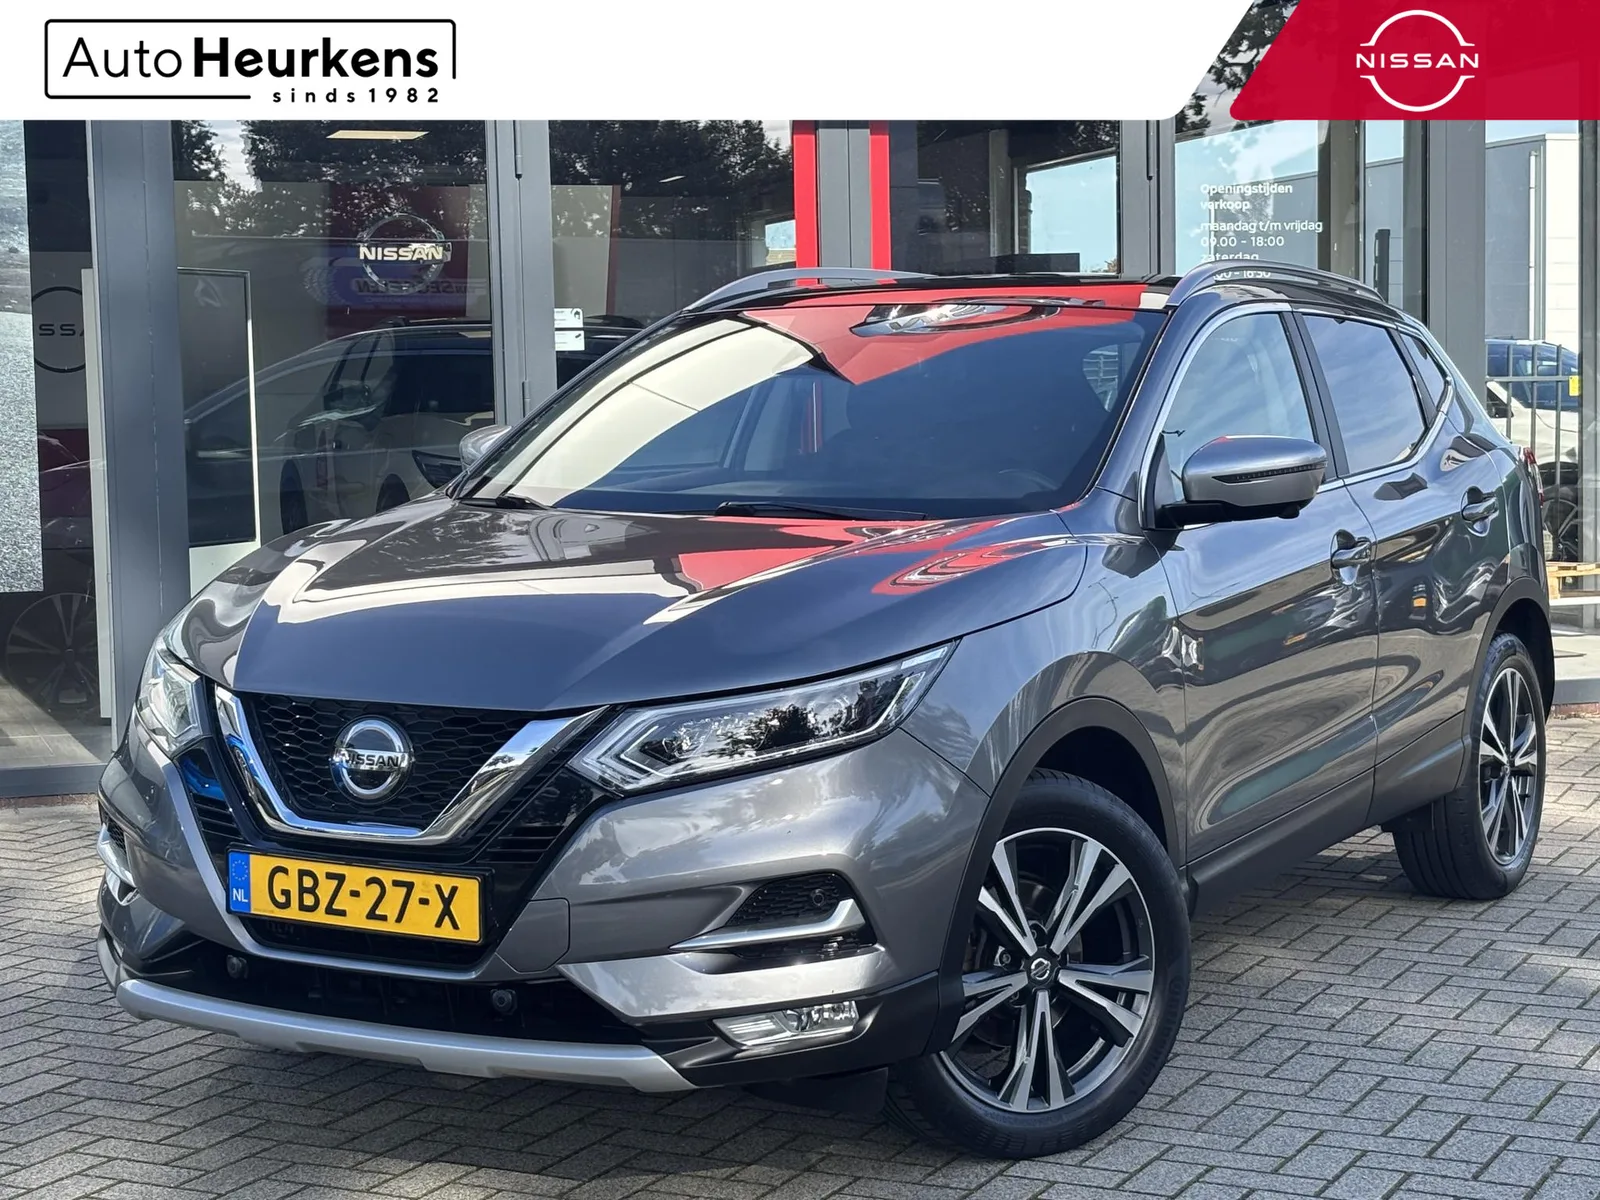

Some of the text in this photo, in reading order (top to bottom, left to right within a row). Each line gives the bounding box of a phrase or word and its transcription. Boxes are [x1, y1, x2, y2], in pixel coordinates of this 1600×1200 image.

[1200, 182, 1293, 196] Openingstijden
[1200, 199, 1251, 211] verkoop
[1200, 220, 1324, 233] maandag t/m vrijdag
[1250, 236, 1285, 247] 18:00
[359, 246, 443, 261] NISSAN
[232, 887, 248, 903] NL
[267, 865, 461, 931] GBZ-27-X
